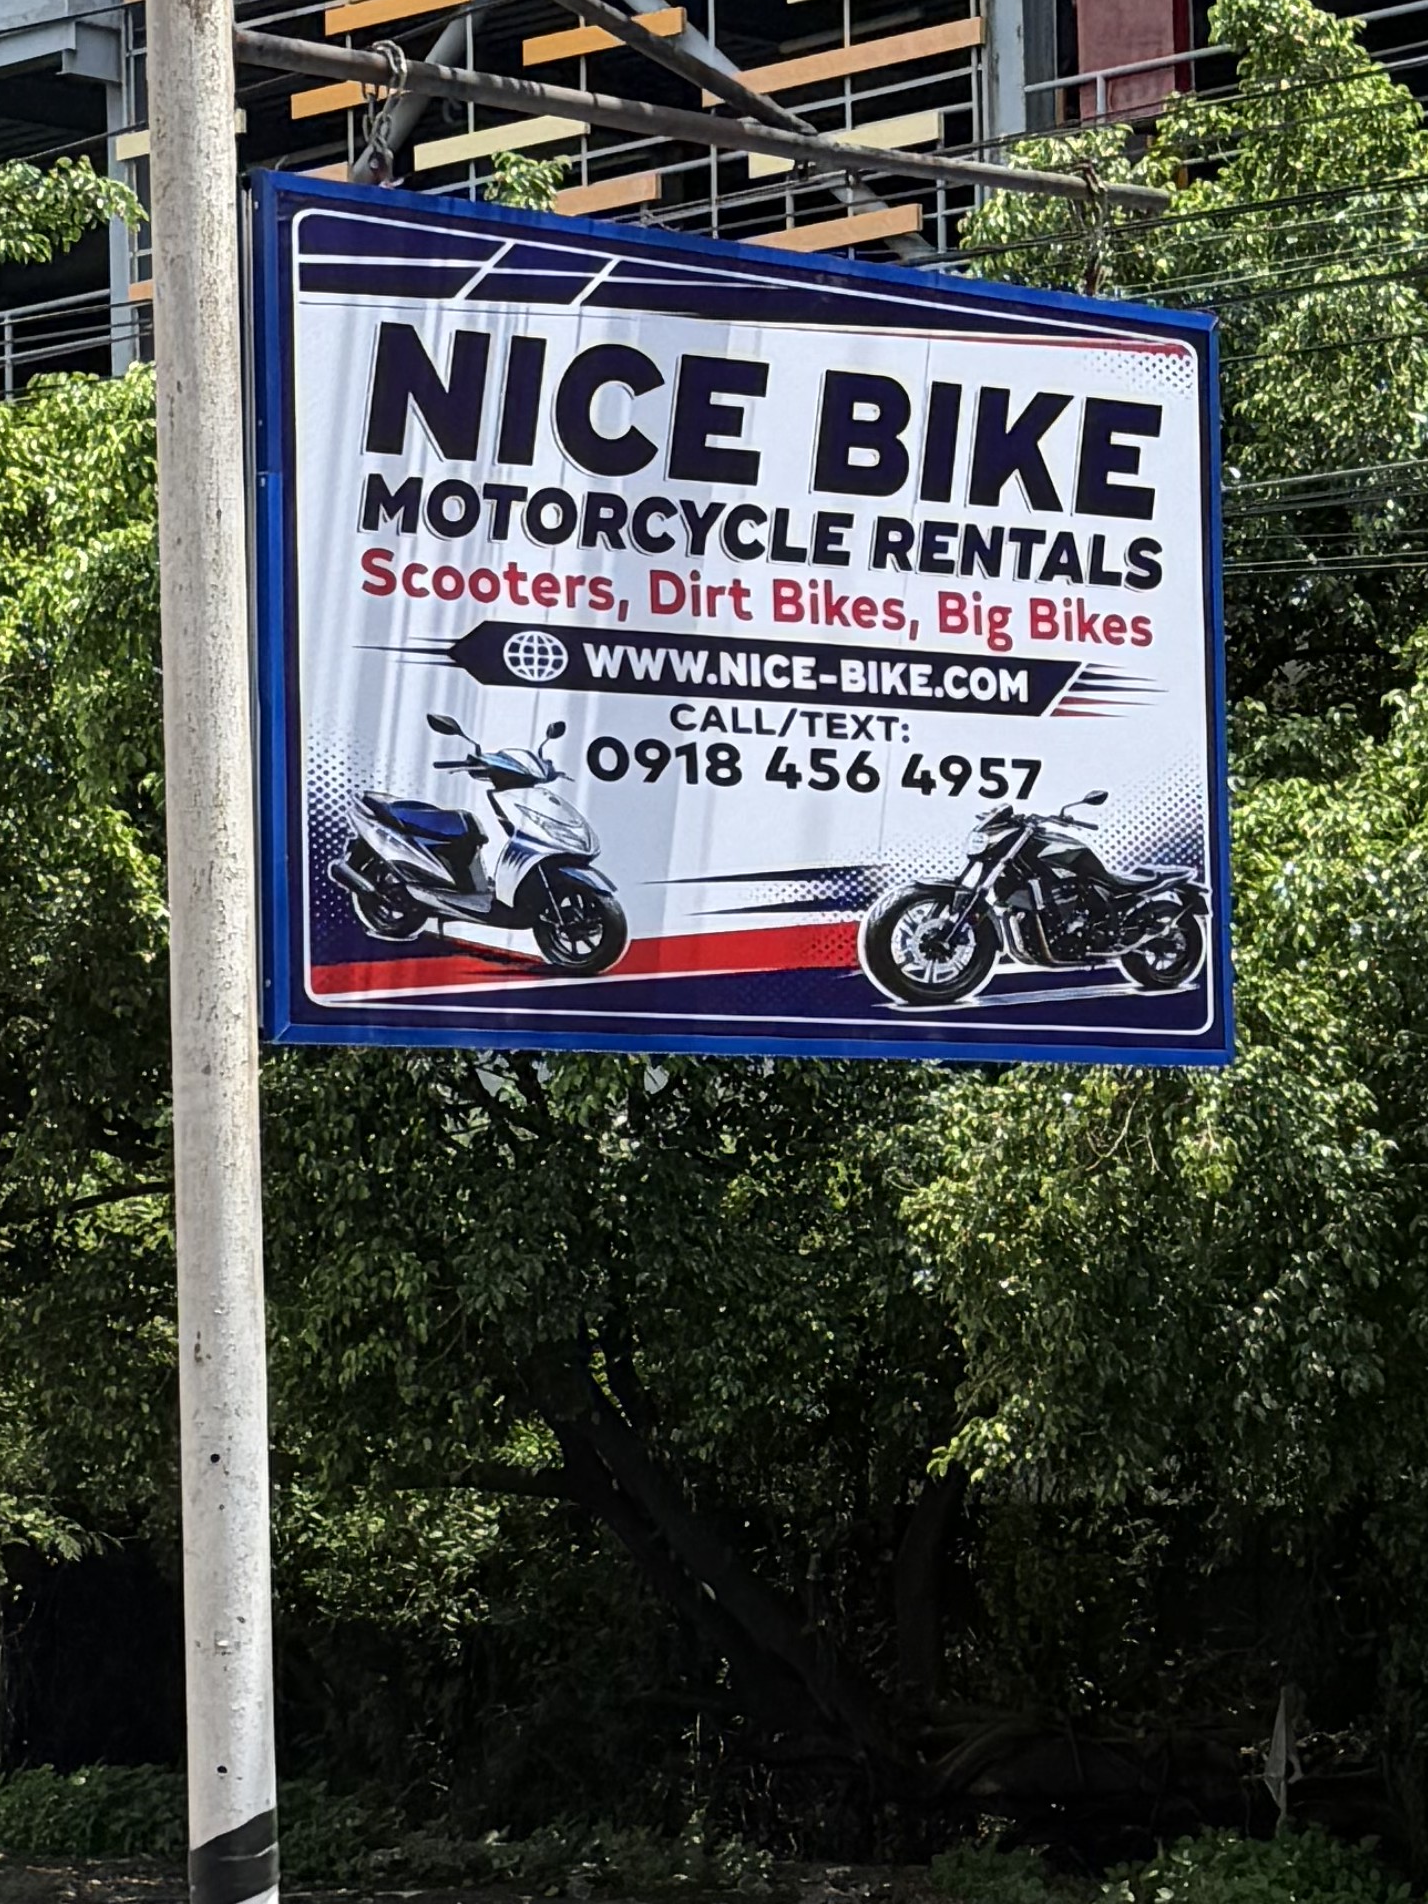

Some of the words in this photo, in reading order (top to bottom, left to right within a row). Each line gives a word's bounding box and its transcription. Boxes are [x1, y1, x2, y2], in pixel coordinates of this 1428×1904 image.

[361, 321, 770, 487] NICE
[813, 367, 1164, 519] BIKE
[357, 472, 852, 568] MOTORCYCLE
[870, 517, 1163, 589] RENTALS
[360, 548, 630, 622] Scooters,
[650, 570, 751, 622] Dirt
[772, 578, 919, 644] Bikes,
[938, 593, 1014, 652] Big
[1030, 601, 1153, 648] Bikes
[583, 640, 1030, 704] WWW.NICE-BIKE.COM
[669, 702, 911, 742] CALL/TEXT:
[585, 742, 743, 790] 0918
[765, 747, 881, 794] 456
[900, 753, 1041, 801] 4957
